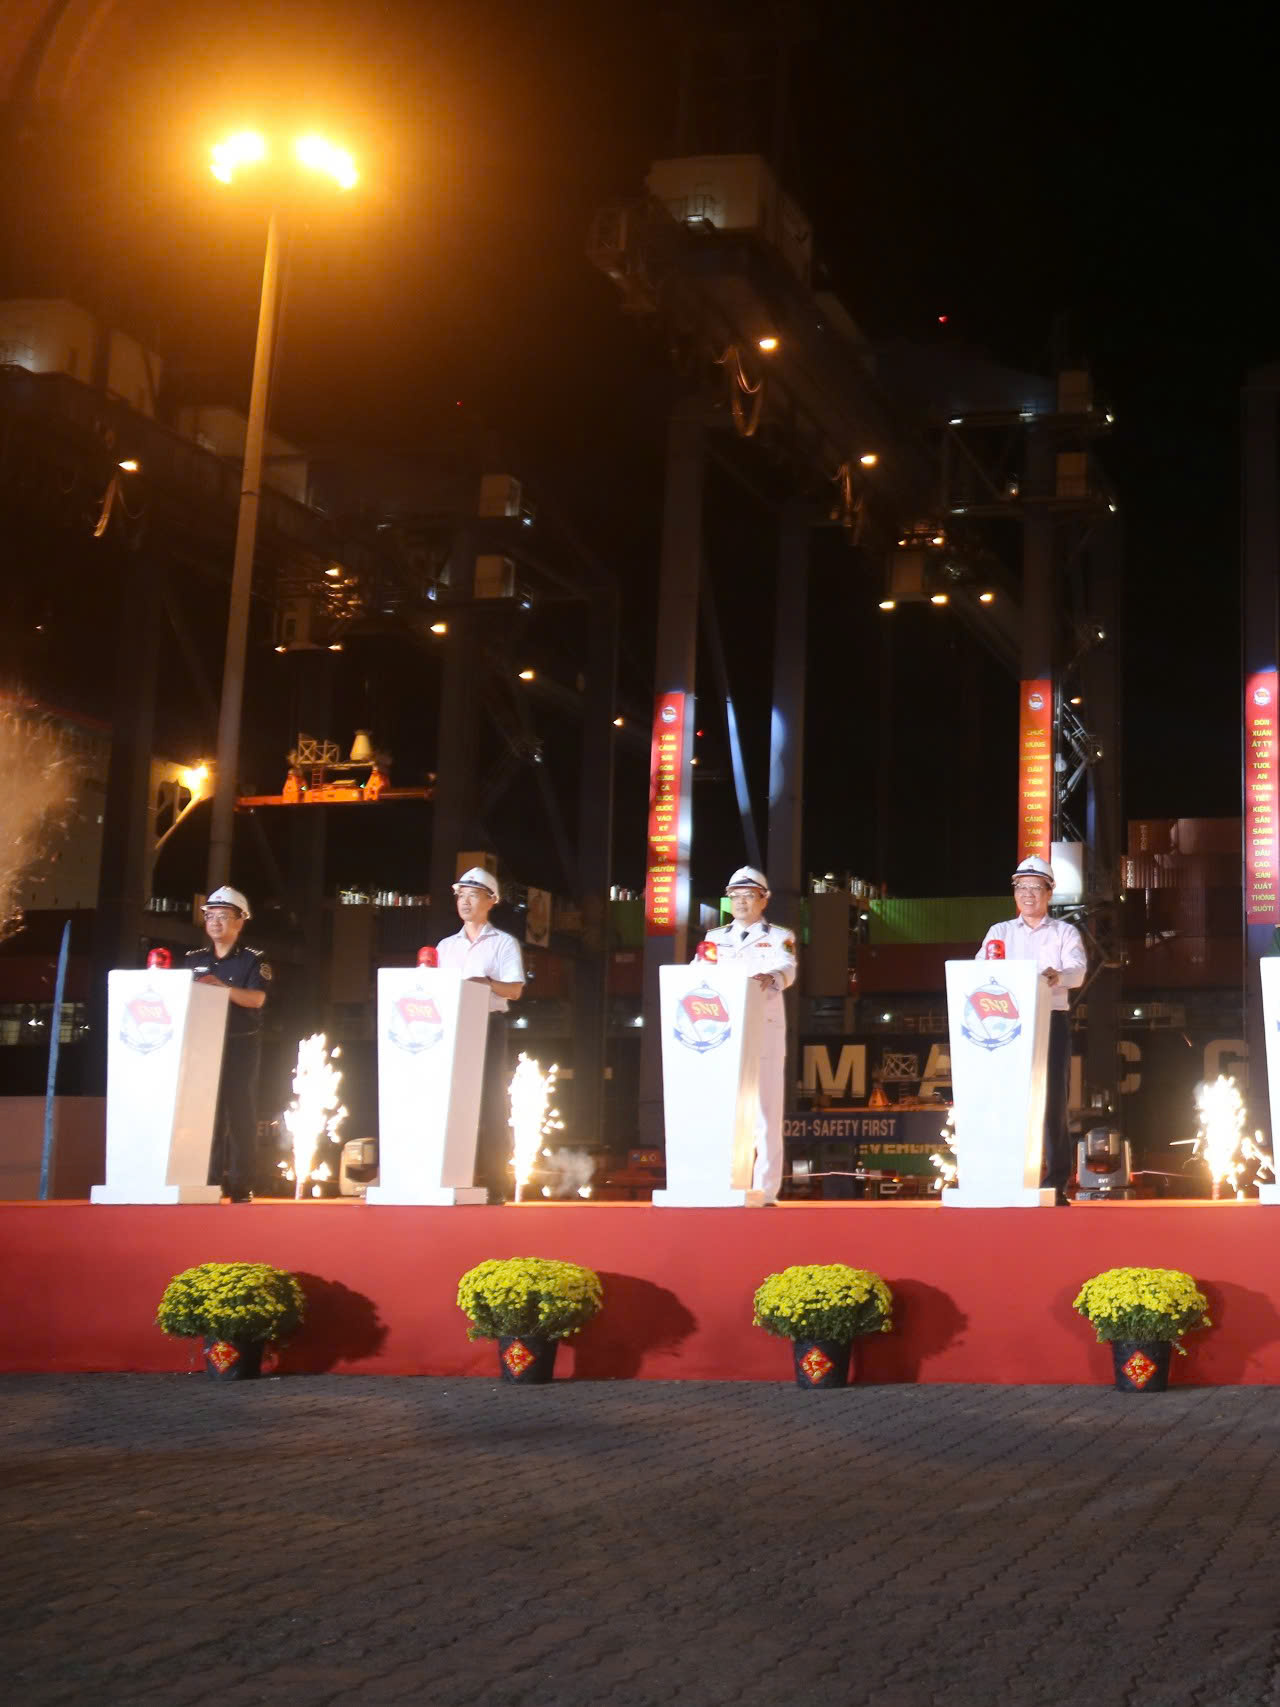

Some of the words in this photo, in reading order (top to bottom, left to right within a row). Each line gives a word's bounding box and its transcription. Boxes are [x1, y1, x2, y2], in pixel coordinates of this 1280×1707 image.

[691, 1001, 720, 1017] SNP
[980, 998, 1009, 1013] SNP
[862, 1119, 896, 1136] FIRST
